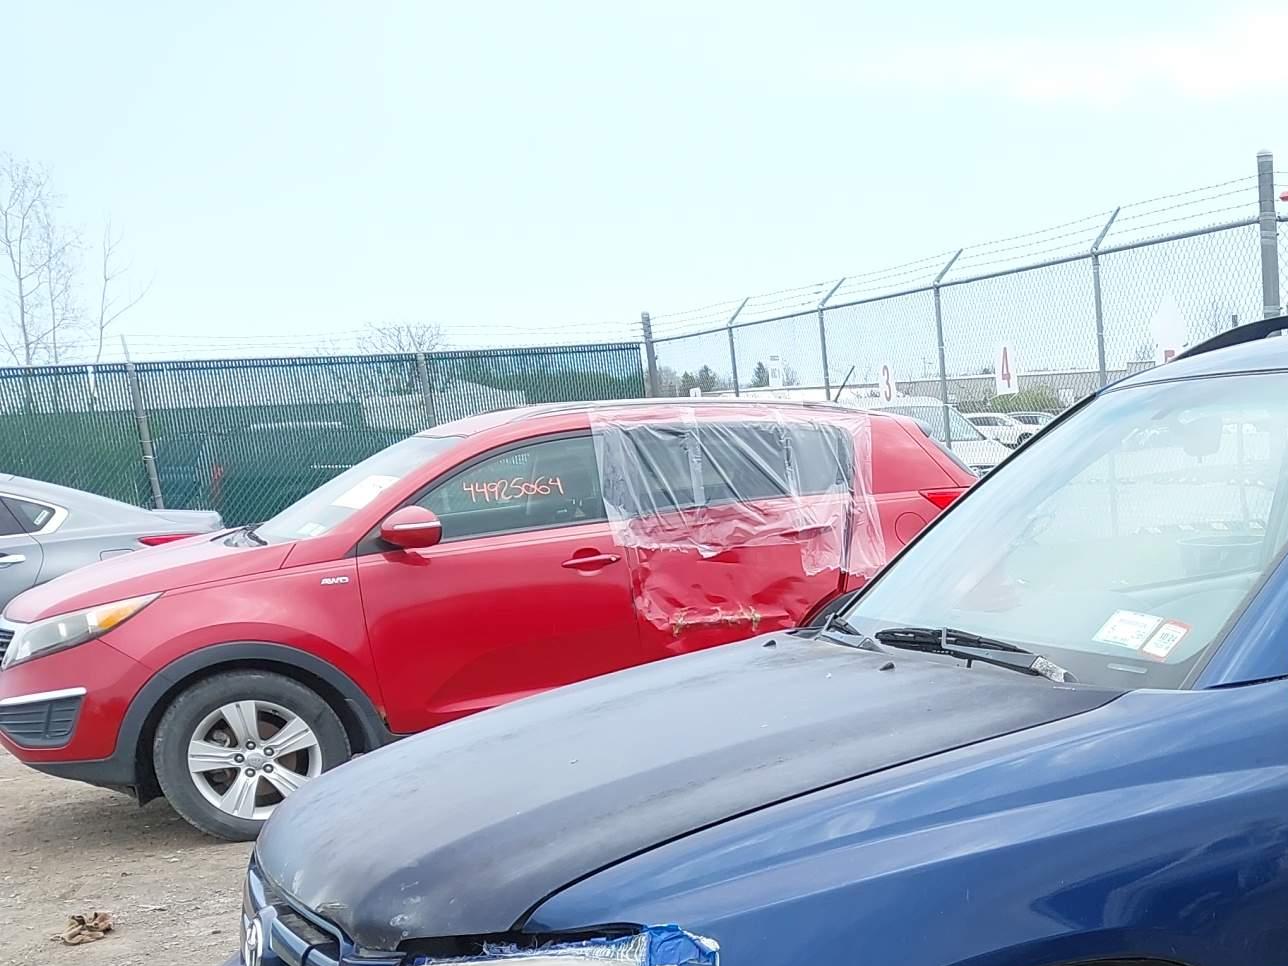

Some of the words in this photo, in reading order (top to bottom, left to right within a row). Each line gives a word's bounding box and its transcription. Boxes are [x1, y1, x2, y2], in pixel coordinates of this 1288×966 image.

[882, 365, 892, 402] 3
[1001, 347, 1011, 388] 4
[462, 476, 565, 503] 44925064
[320, 576, 350, 585] AWD
